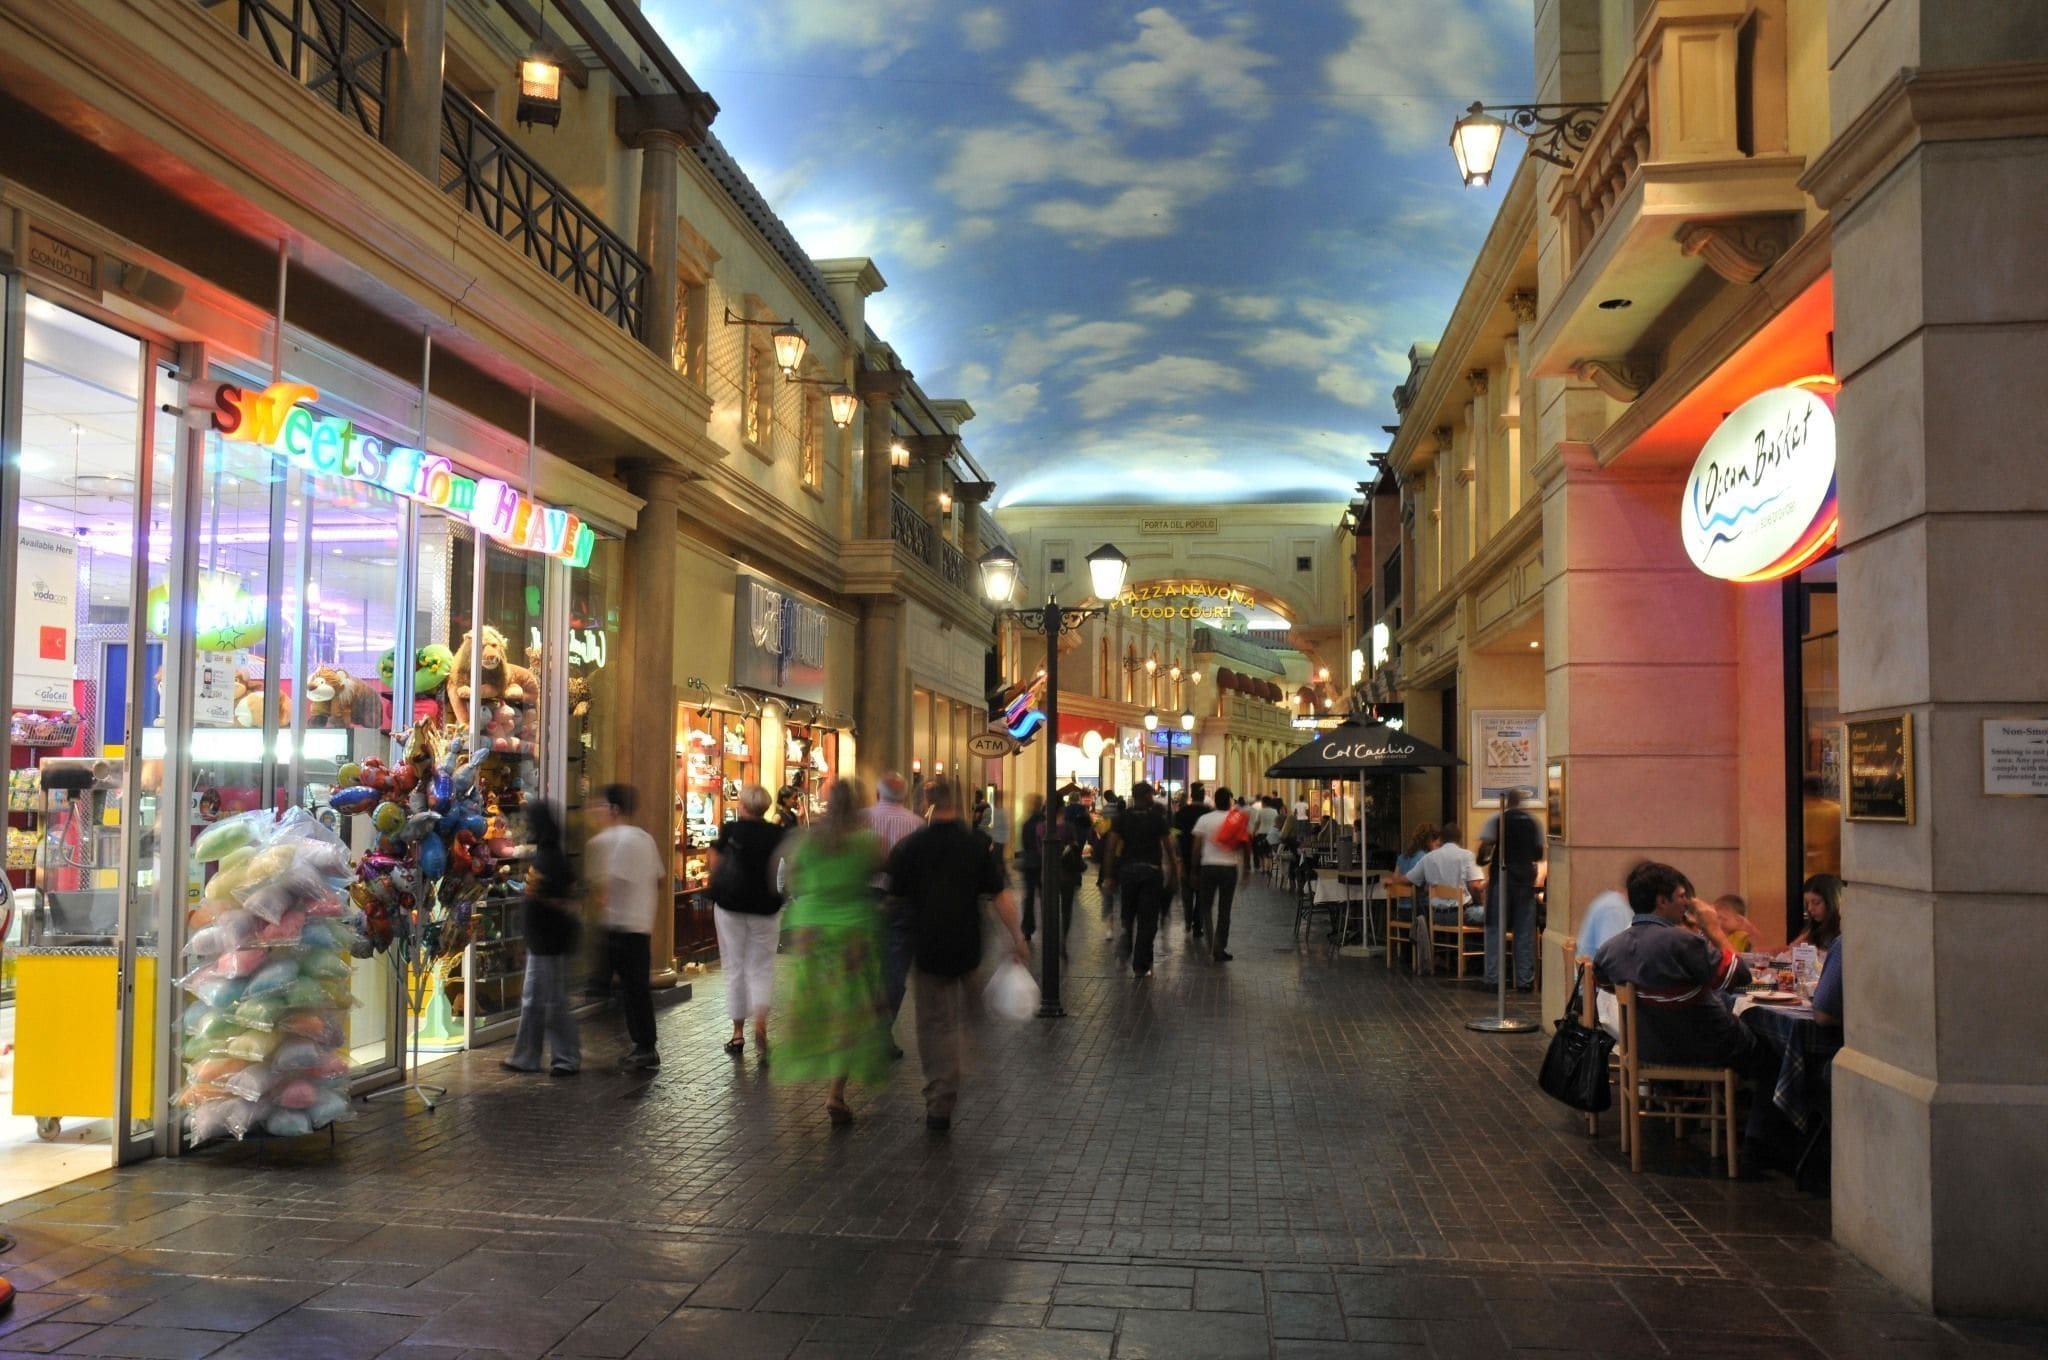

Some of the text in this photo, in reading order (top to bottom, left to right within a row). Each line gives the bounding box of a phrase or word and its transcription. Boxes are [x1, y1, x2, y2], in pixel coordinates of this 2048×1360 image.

[51, 241, 72, 259] VIA
[31, 248, 89, 281] CONDOTTI
[1752, 399, 1813, 487] Basket
[1144, 521, 1169, 529] PORTA
[1185, 520, 1215, 528] POPOLO
[20, 537, 73, 555] Available Here
[33, 590, 68, 601] vodacom
[1110, 584, 1256, 610] PIAZZA NAVONA
[1131, 606, 1234, 619] FOOD COURT
[975, 740, 1003, 751] ATM
